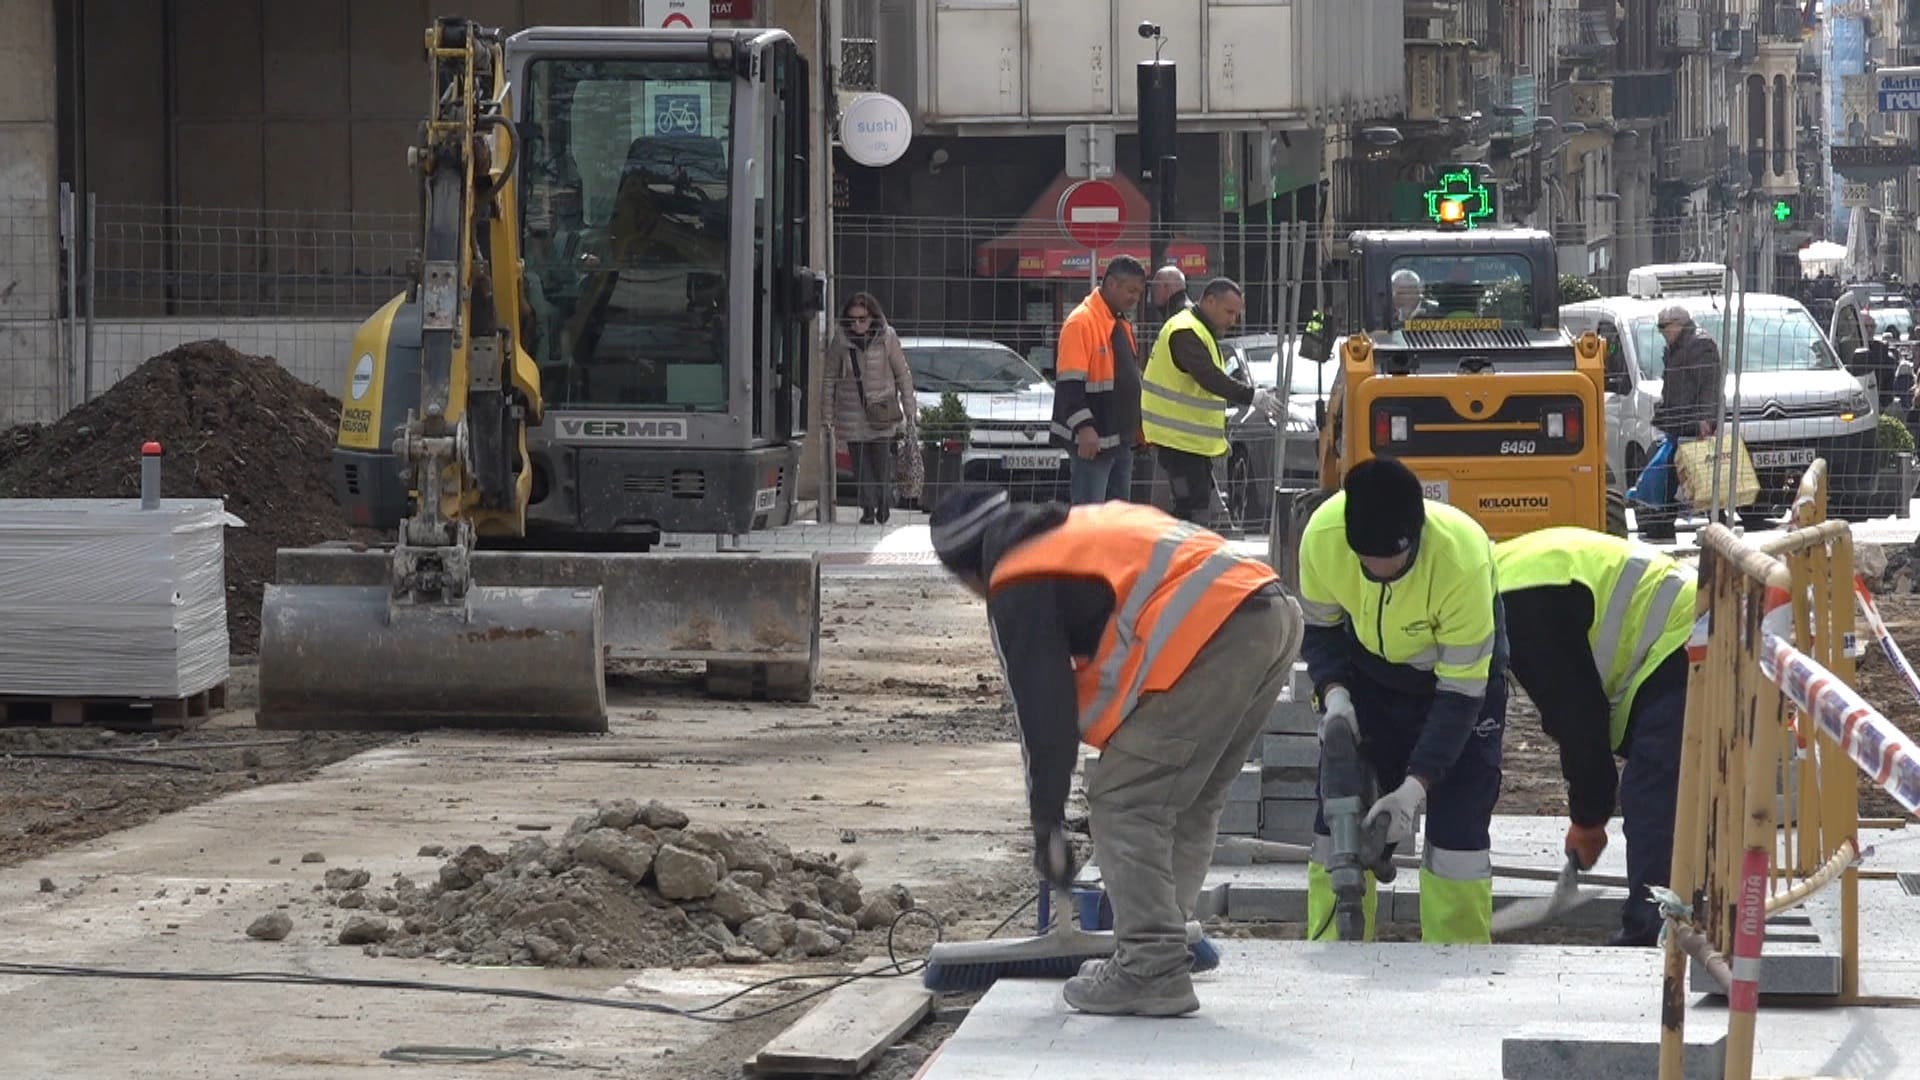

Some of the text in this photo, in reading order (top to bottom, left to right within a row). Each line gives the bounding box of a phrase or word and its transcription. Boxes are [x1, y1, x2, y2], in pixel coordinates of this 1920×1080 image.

[857, 117, 898, 133] sushi
[560, 420, 682, 437] VERMA
[1500, 440, 1536, 454] S450
